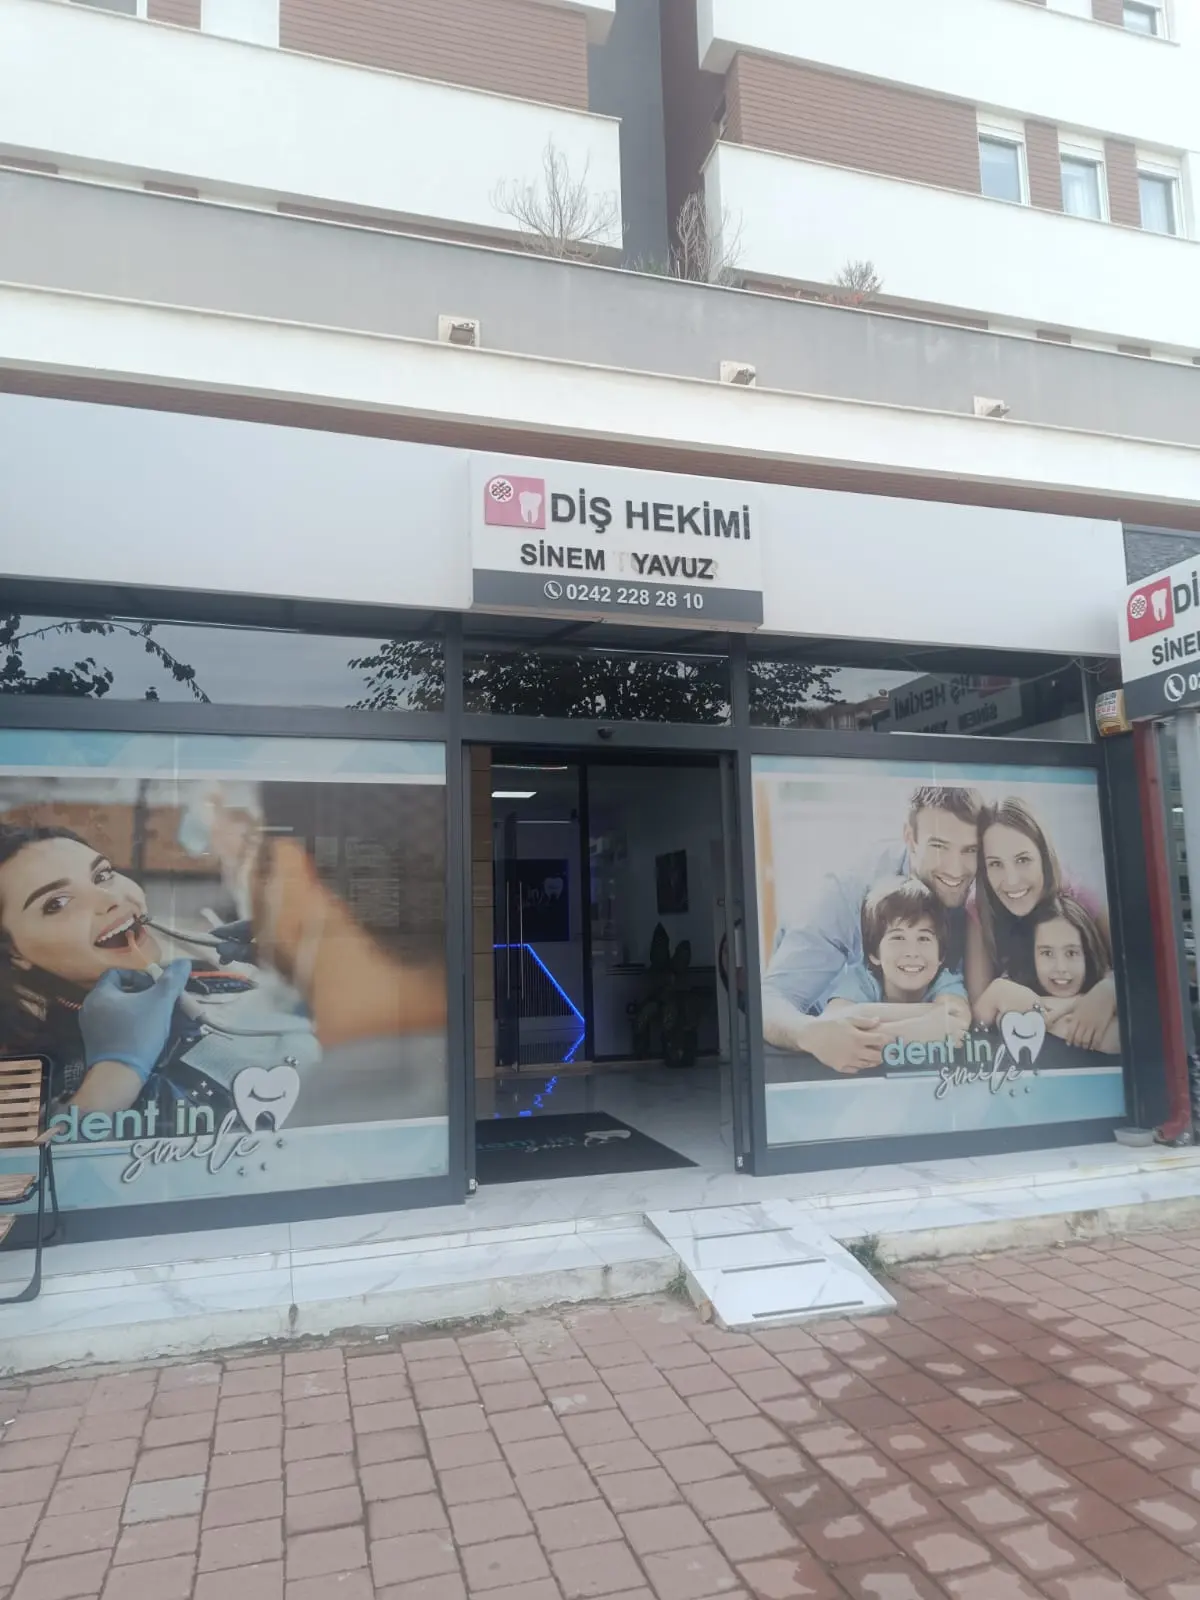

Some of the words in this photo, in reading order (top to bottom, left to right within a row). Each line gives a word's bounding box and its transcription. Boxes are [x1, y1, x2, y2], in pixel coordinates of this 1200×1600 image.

[551, 488, 612, 533] DİŞ
[626, 500, 751, 540] HEKİMİ
[520, 540, 605, 571] SİNEM
[632, 552, 715, 580] YAVUZ
[566, 583, 611, 602] 0242
[617, 587, 650, 606] 228
[655, 591, 678, 608] 28
[683, 592, 704, 610] 10
[882, 1034, 955, 1066] dent
[964, 1033, 992, 1063] in
[934, 1044, 1023, 1099] smile
[49, 1100, 159, 1143] dent
[176, 1100, 214, 1135] in
[121, 1109, 260, 1183] smile
